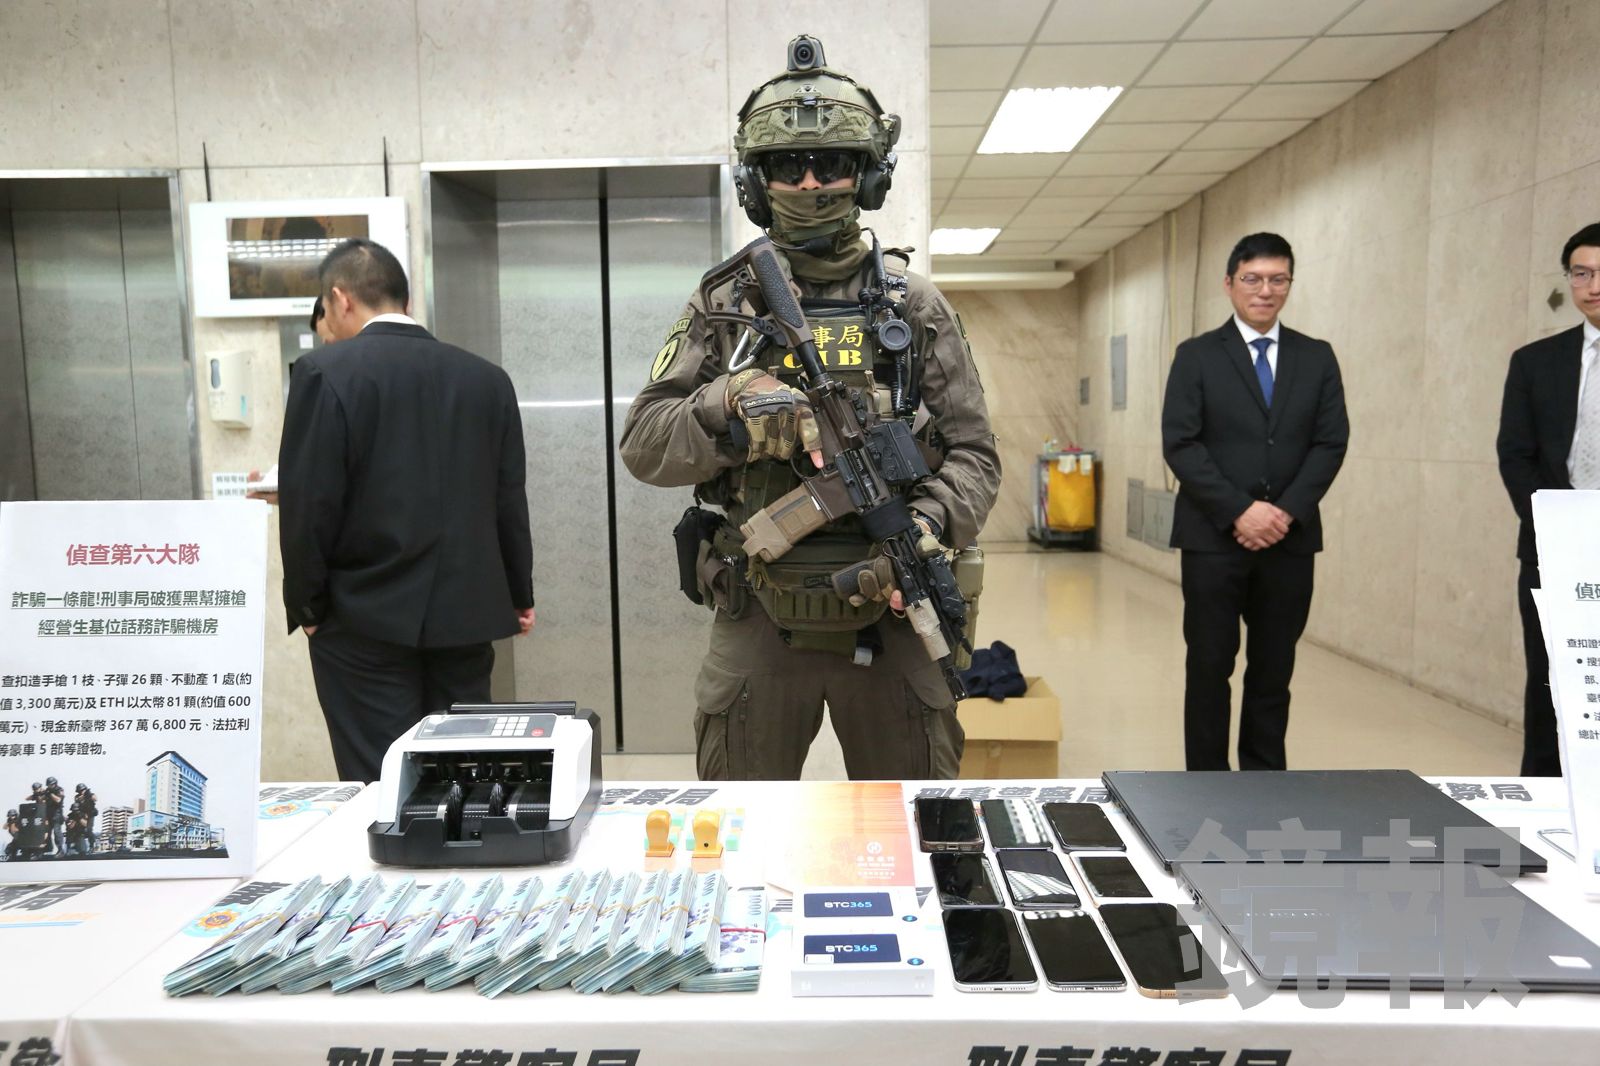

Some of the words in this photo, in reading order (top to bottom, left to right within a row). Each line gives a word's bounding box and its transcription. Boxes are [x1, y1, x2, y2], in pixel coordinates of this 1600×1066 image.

[66, 543, 200, 566] 偵查第六大隊
[38, 618, 219, 636] 經營生基位話務詐騙機房
[2, 675, 67, 688] 查扣造手槍
[72, 676, 78, 686] 1
[132, 674, 147, 686] 26
[213, 674, 218, 685] 1
[16, 698, 51, 711] 3,300
[100, 697, 125, 708] ETH
[127, 696, 165, 709] 以太幣
[167, 697, 181, 708] 81
[228, 696, 251, 707] 600
[110, 720, 133, 731] 367
[136, 718, 149, 732] 萬
[152, 719, 186, 732] 6,800
[1578, 730, 1600, 740] 總計
[40, 744, 47, 755] 5
[824, 901, 873, 909] BTC365
[825, 944, 878, 953] BTC365
